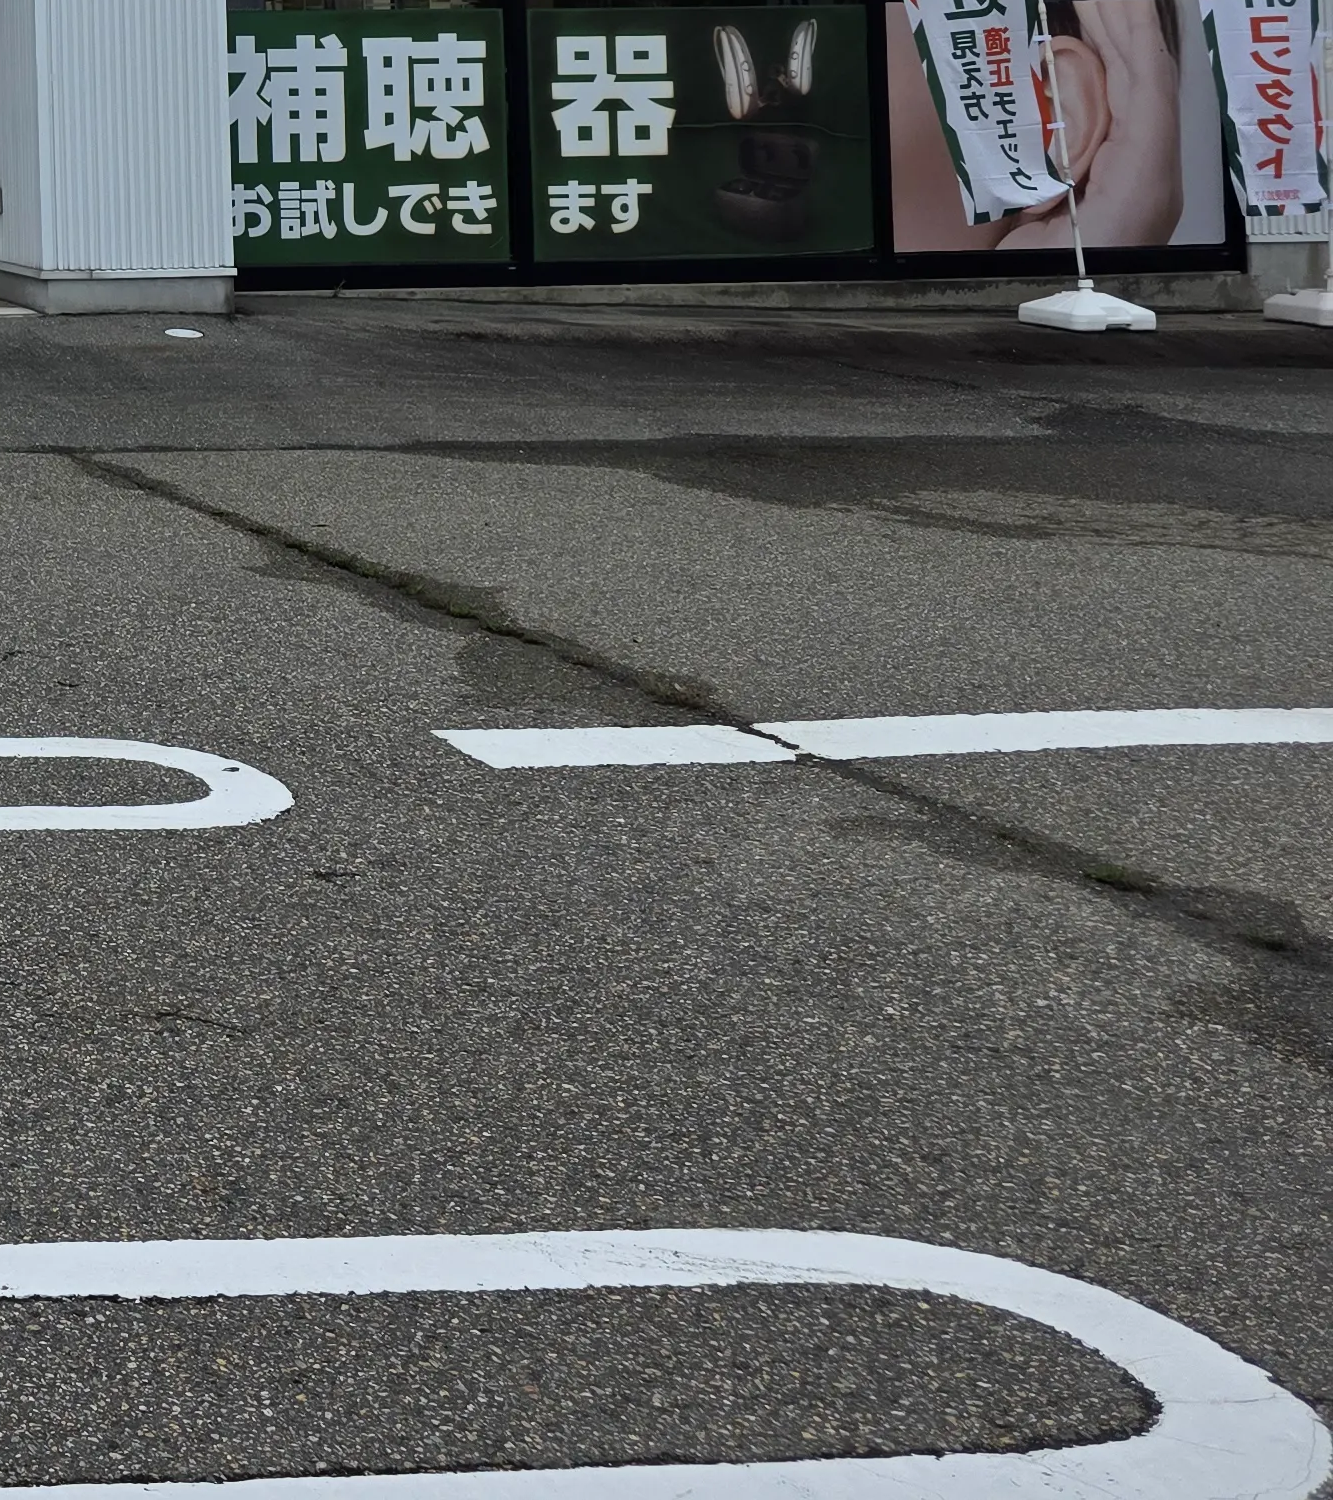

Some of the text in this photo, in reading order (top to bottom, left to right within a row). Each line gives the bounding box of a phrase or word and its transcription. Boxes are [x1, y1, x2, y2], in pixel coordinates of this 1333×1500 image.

[228, 33, 676, 163] 補聴器
[231, 179, 653, 240] お試しできます
